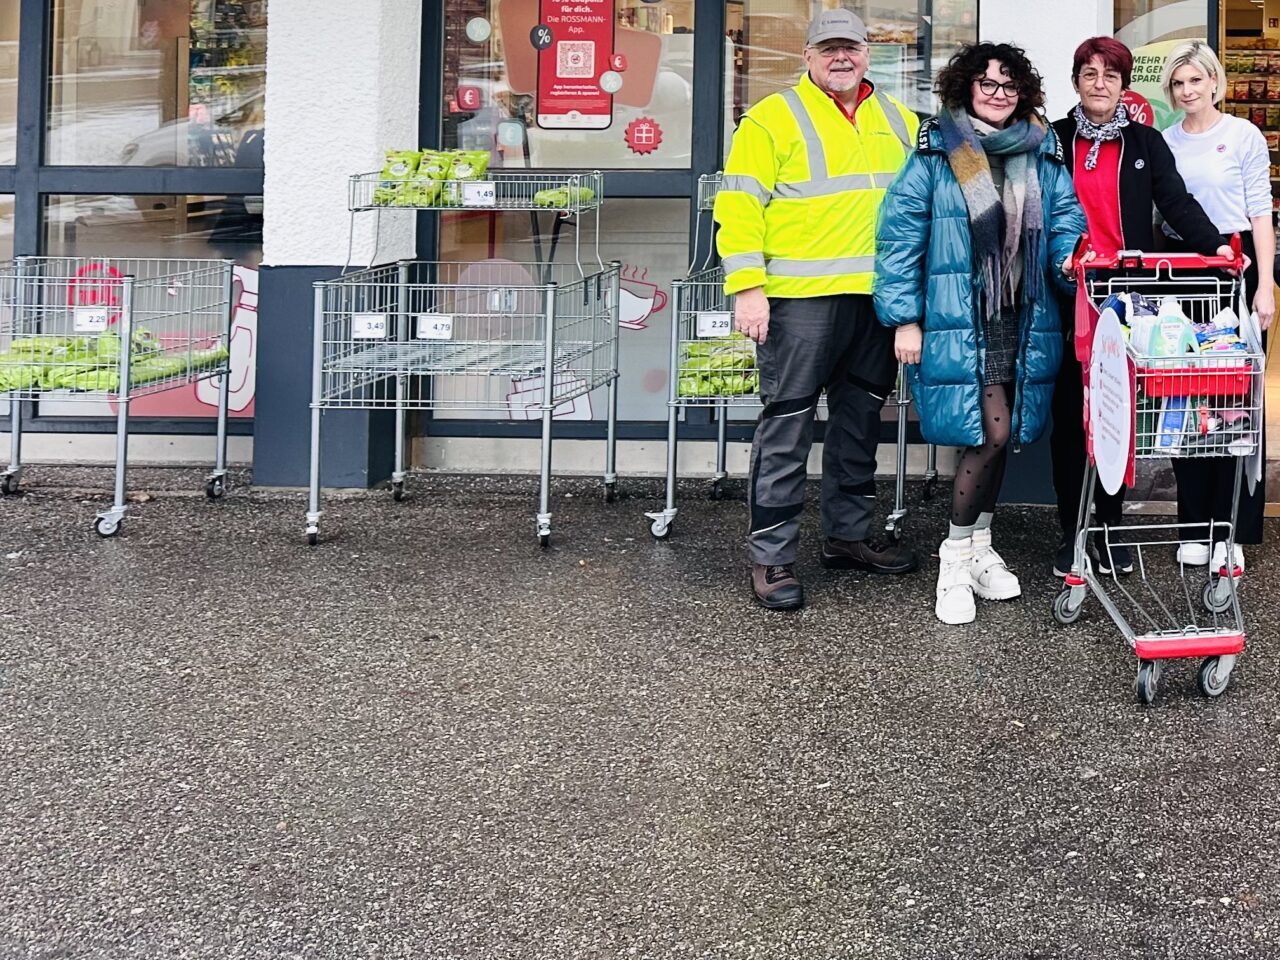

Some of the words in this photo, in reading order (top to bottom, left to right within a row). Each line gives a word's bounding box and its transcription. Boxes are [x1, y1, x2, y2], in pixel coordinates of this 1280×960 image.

[561, 5, 573, 13] für
[574, 5, 592, 13] dich.
[547, 15, 560, 23] Die
[561, 15, 606, 23] ROSSMANN-
[568, 25, 585, 34] App.
[476, 190, 494, 199] 1,49
